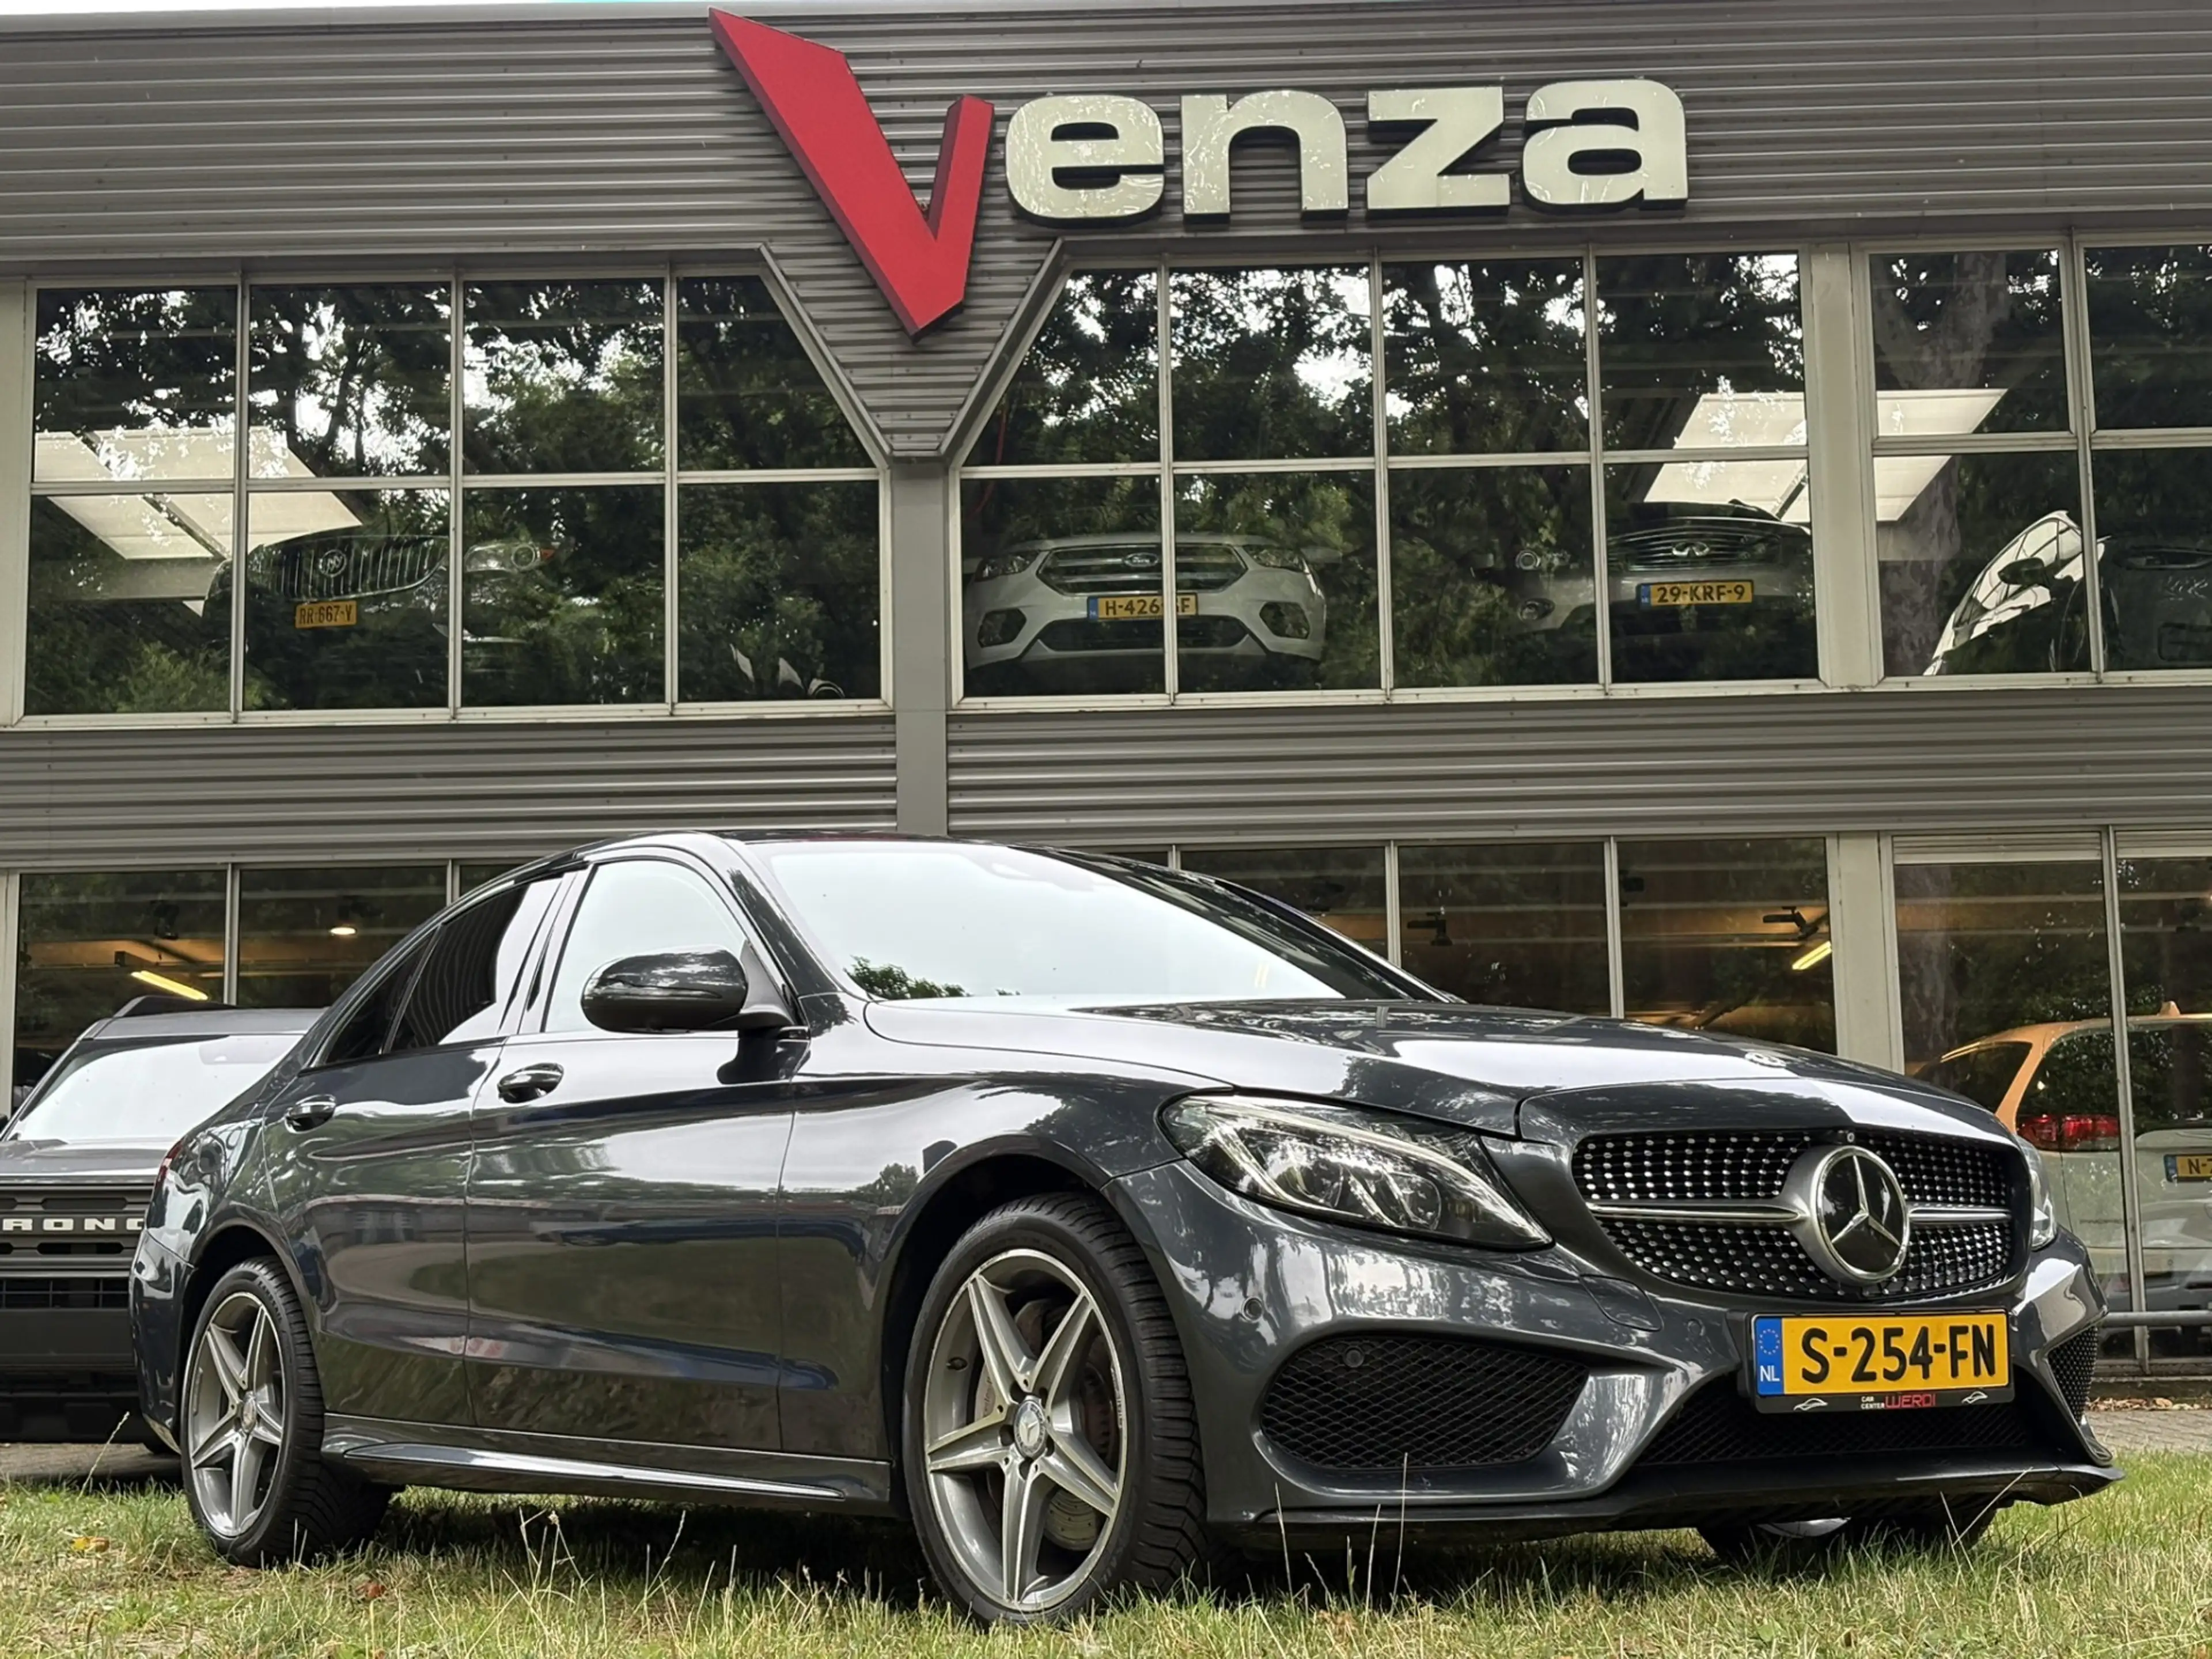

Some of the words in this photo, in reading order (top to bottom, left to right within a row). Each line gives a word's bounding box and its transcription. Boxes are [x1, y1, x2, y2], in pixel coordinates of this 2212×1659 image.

[709, 7, 1689, 338] Venza
[1657, 584, 1745, 603] 29-KRF-9
[1760, 1365, 1781, 1382] NL
[1801, 1324, 1996, 1384] S-254-FN
